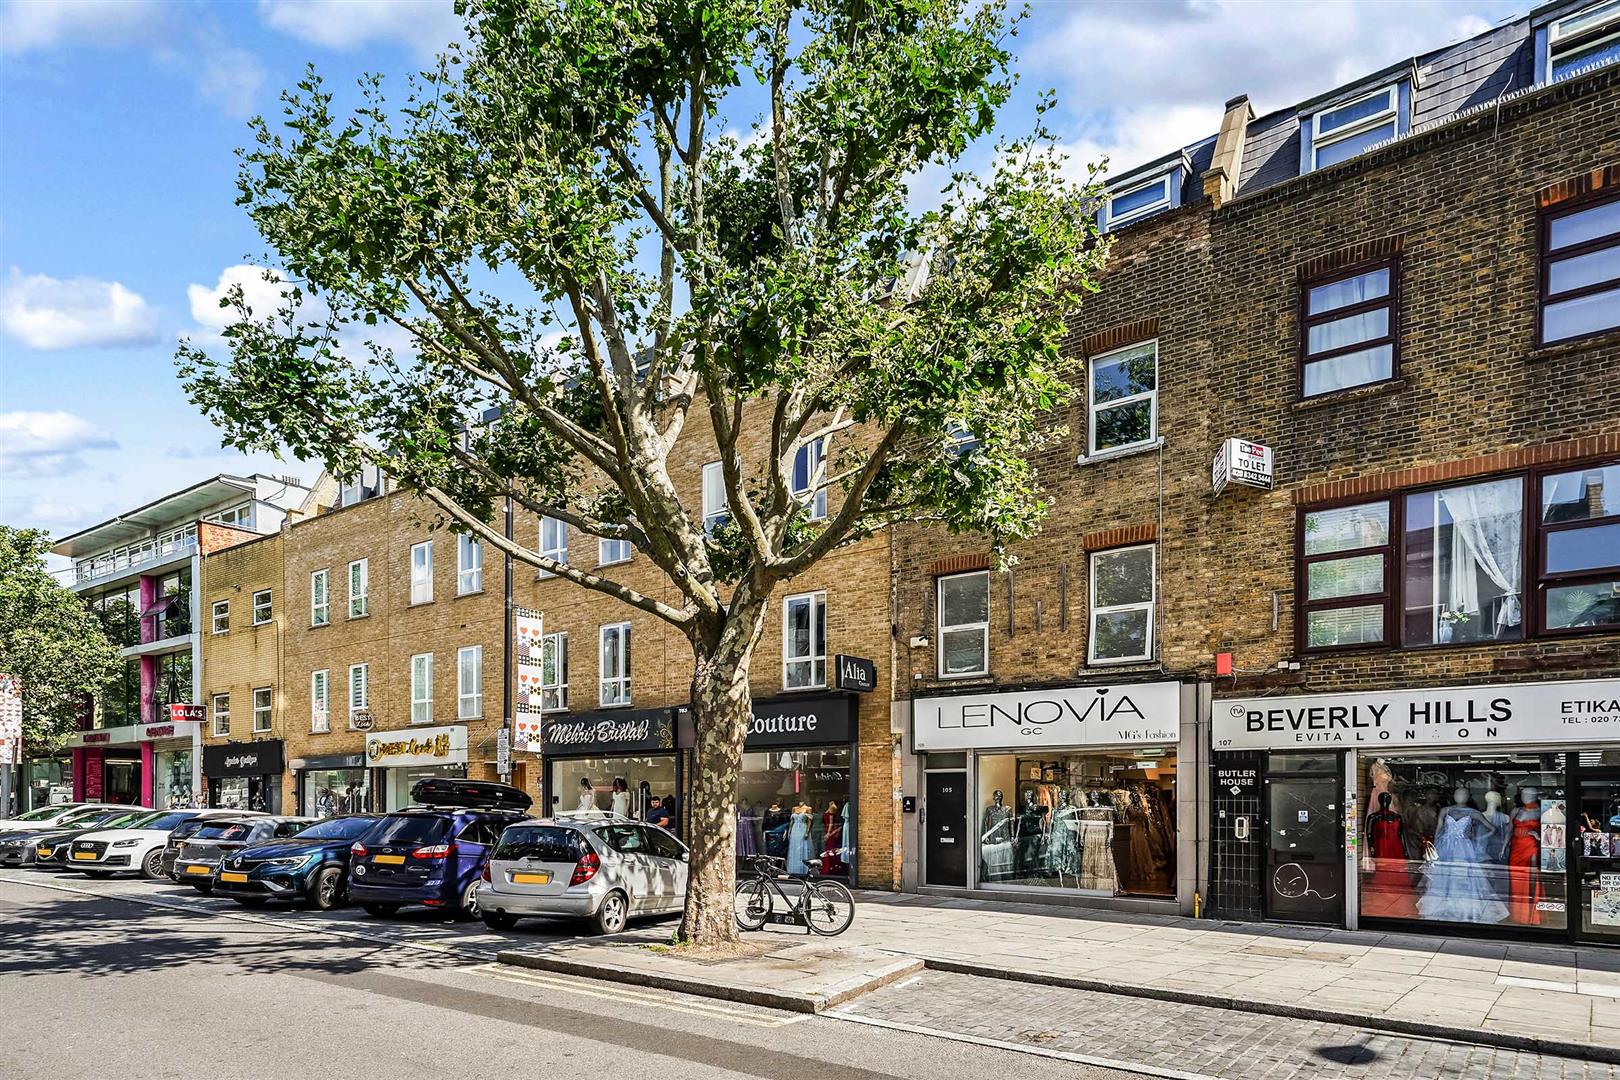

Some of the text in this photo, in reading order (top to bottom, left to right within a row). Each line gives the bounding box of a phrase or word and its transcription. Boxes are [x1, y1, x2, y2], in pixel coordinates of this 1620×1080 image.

[1238, 458, 1266, 472] TO LET
[1244, 471, 1257, 480] 8342
[844, 661, 866, 681] Alia
[172, 709, 203, 717] LOLA'S
[938, 688, 1146, 729] LENOVIA
[1246, 698, 1512, 732] BEVERLY HILLS
[747, 713, 817, 734] Couture
[597, 719, 649, 743] Bridal
[1020, 728, 1043, 736] GC
[1145, 729, 1176, 739] Fashion
[1295, 732, 1342, 742] EVITA
[1220, 778, 1254, 786] HOUSE
